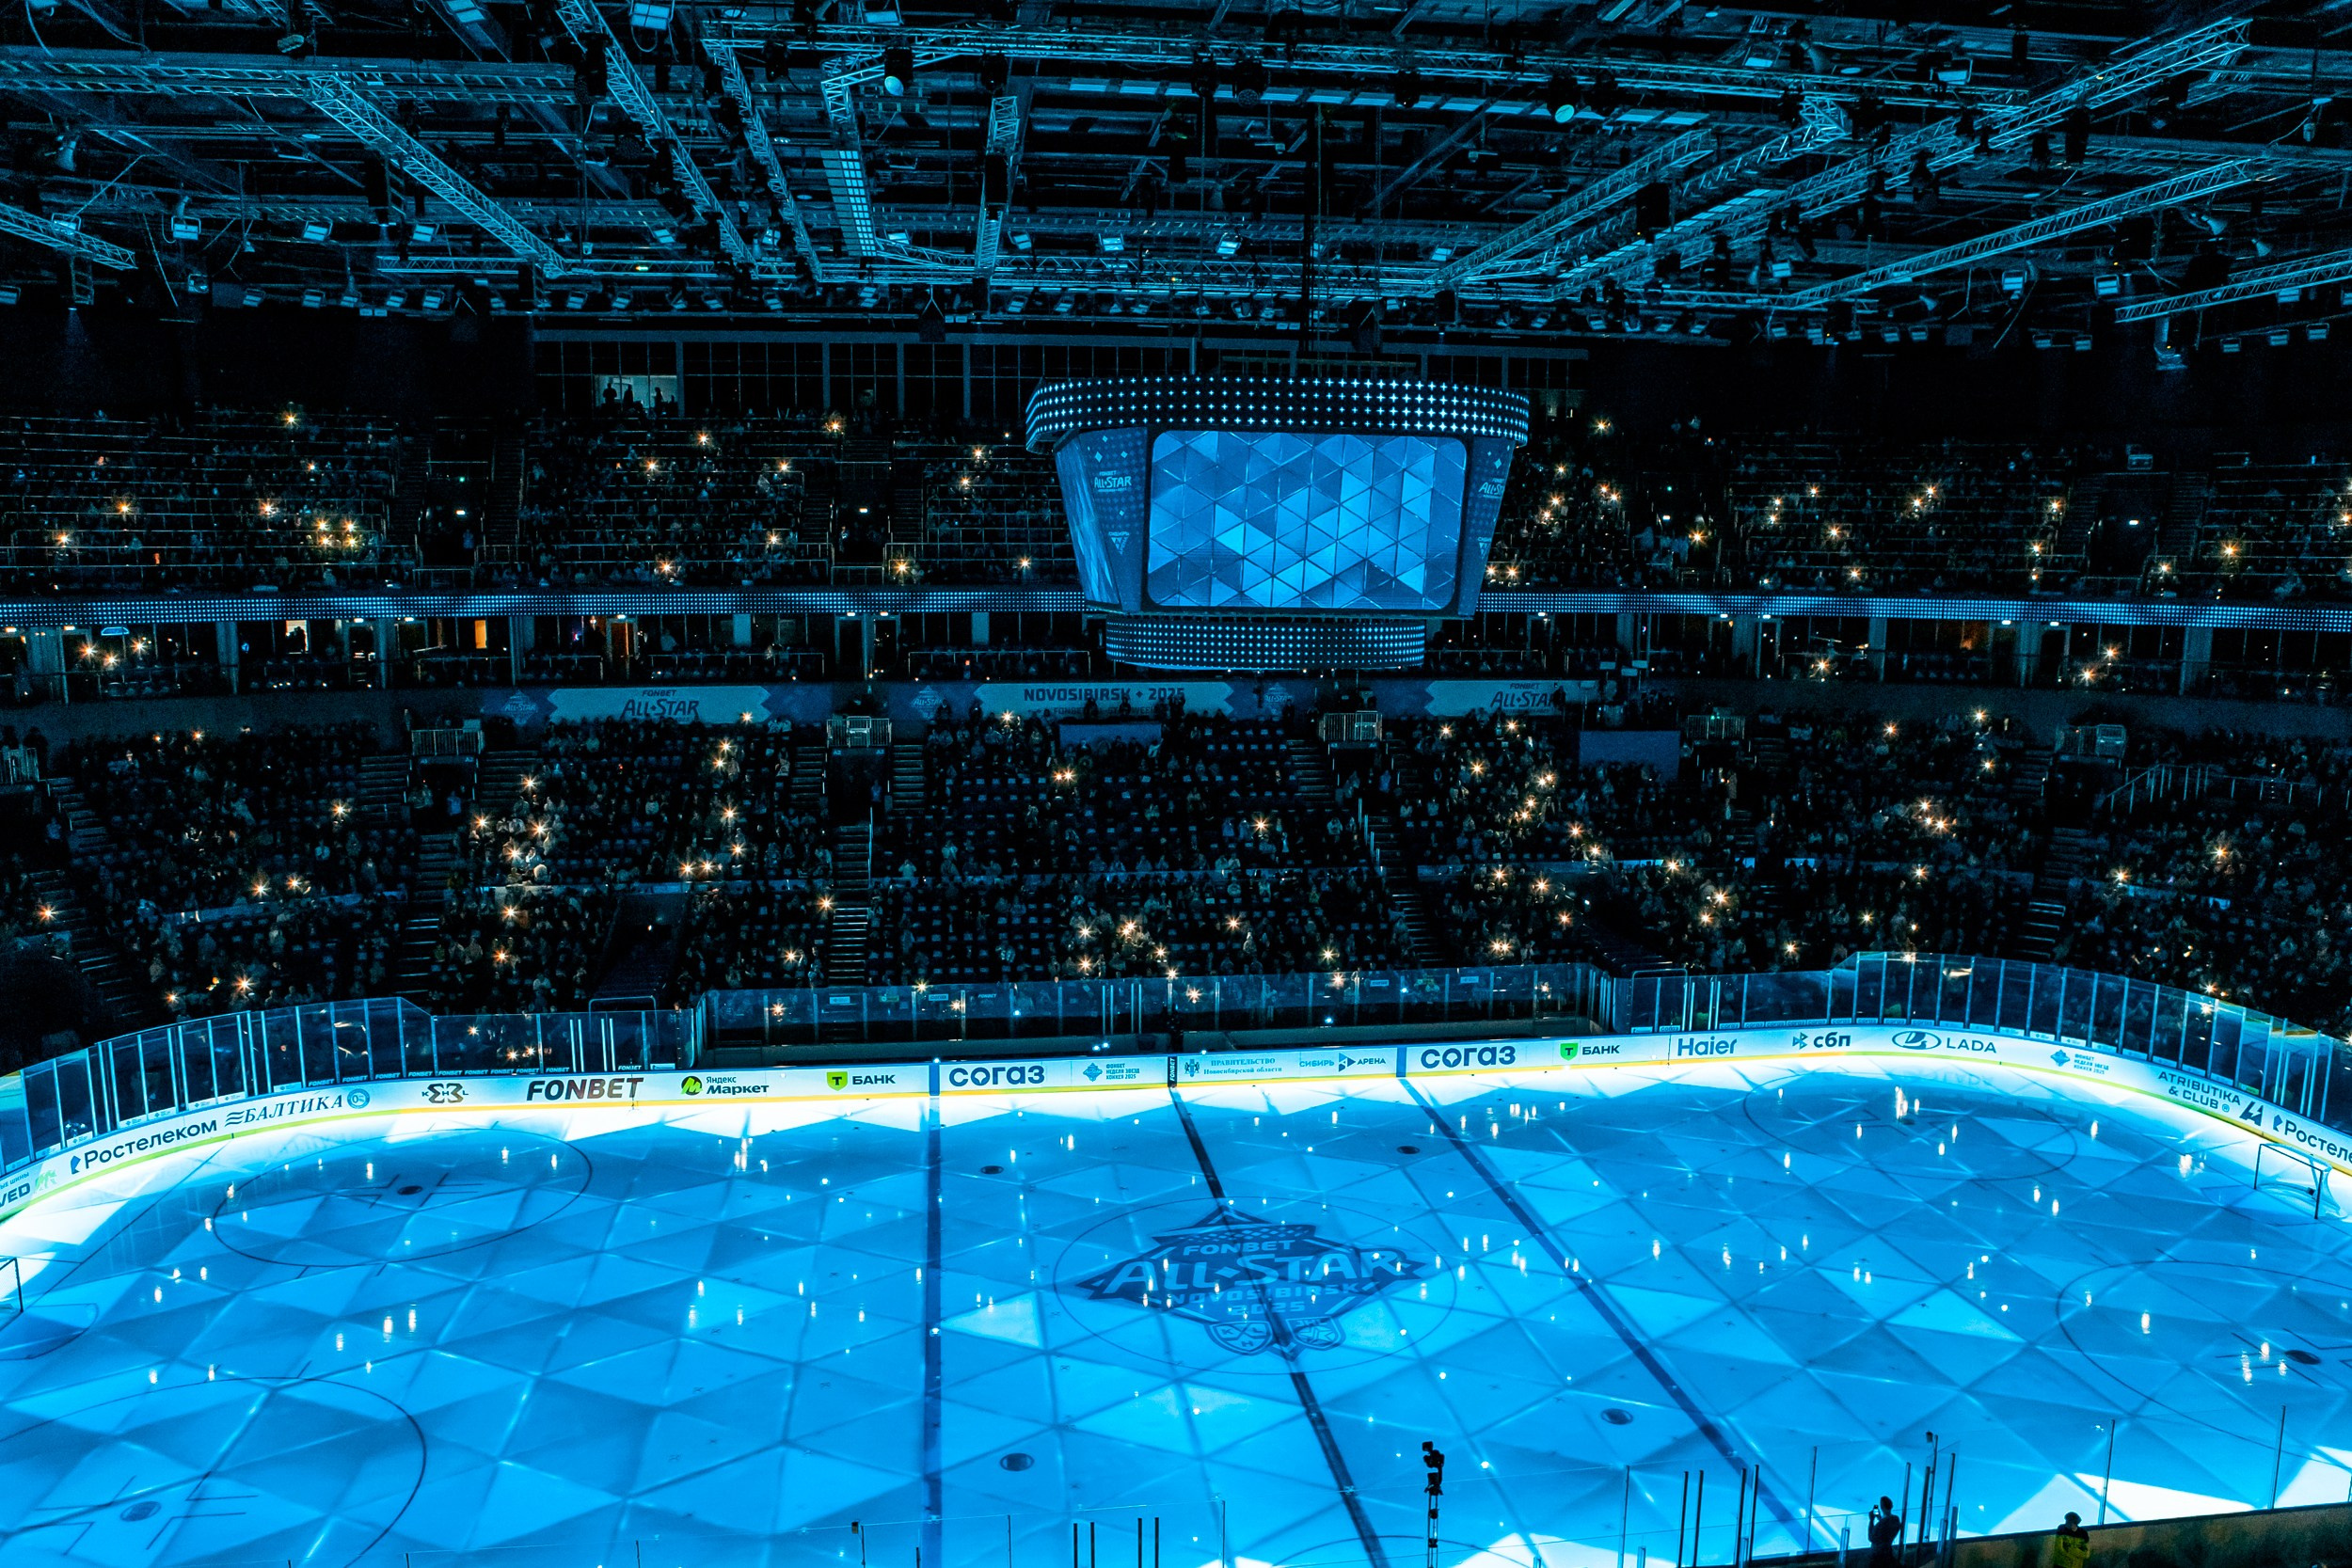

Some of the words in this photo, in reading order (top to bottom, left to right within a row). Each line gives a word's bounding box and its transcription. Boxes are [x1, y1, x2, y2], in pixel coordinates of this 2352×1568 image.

[1677, 1036, 1738, 1056] Haier
[1813, 1032, 1851, 1048] сбп
[1947, 1037, 1996, 1053] LADA
[1582, 1045, 1620, 1055] БАНК
[1204, 1067, 1255, 1075] Новосибирской
[1299, 1059, 1335, 1068] СИБИРЬ
[852, 1074, 896, 1085] БАНК
[527, 1077, 644, 1101] FONBET
[707, 1085, 769, 1095] Маркет
[2158, 1071, 2241, 1105] ATRIBUTIKA
[2183, 1089, 2218, 1109] CLUB
[244, 1094, 343, 1123] БАЛТИКА
[84, 1119, 217, 1169] Ростелеком
[1184, 1240, 1295, 1256] FONBET
[1232, 1302, 1305, 1315] 2025
